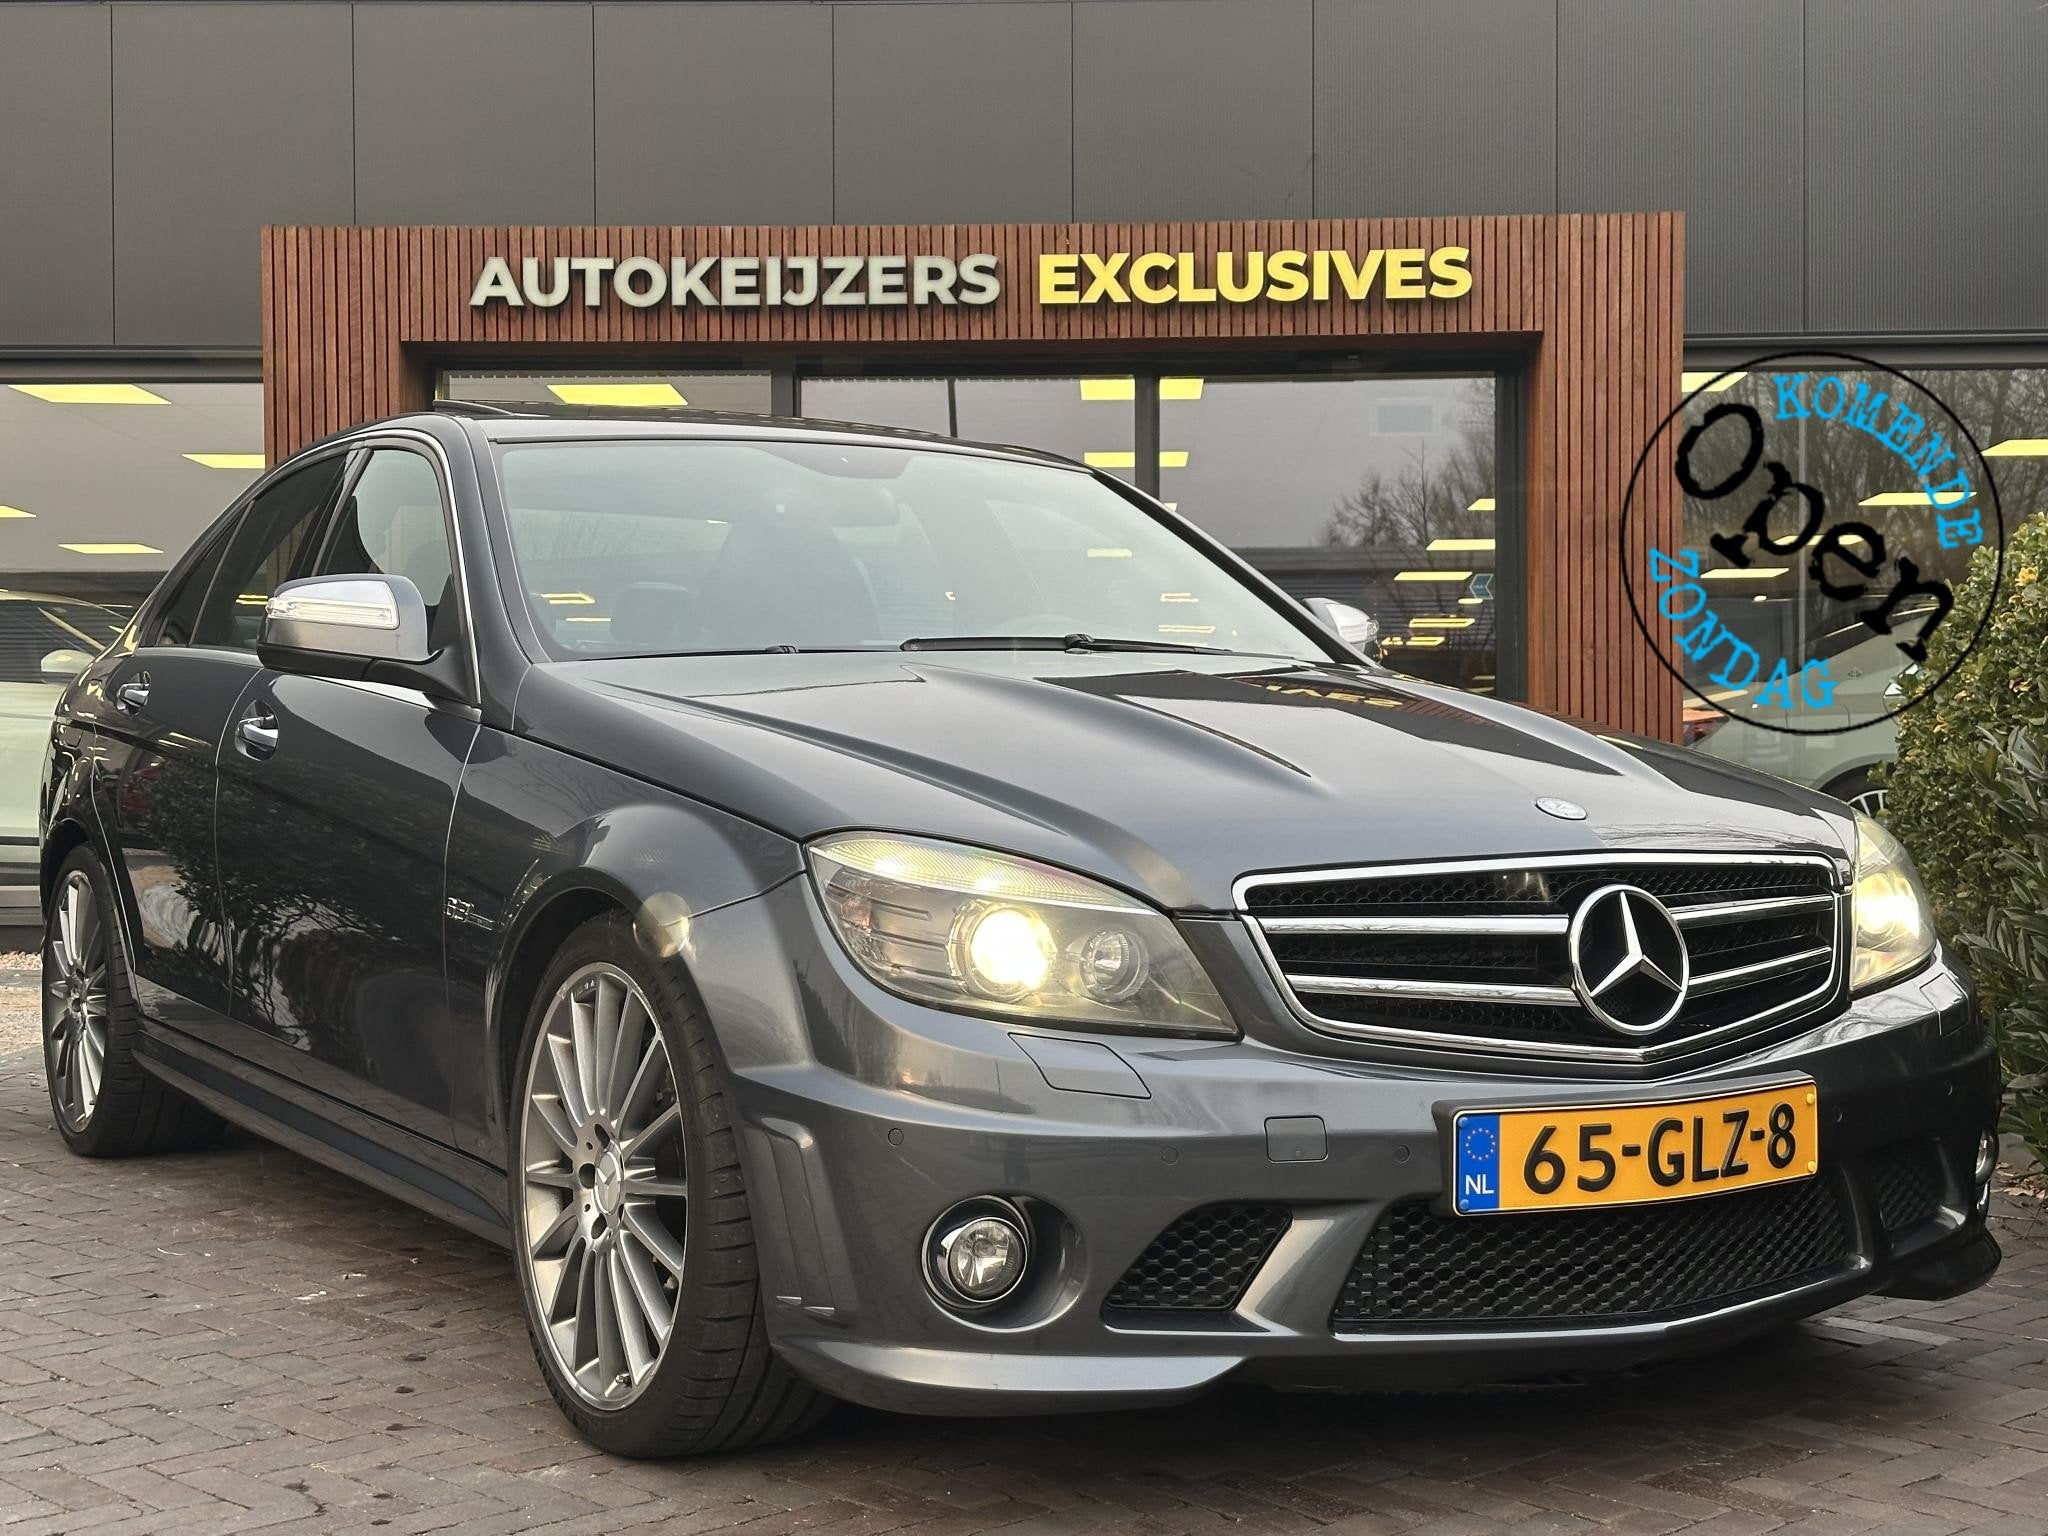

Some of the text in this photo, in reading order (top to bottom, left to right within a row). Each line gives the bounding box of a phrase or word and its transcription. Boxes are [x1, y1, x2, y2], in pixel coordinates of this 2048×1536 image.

[469, 246, 1473, 308] AUTOKEIJZERS EXCLUSIVES
[1523, 1102, 1796, 1195] 65-GLZ-8
[1465, 1174, 1495, 1195] NL
